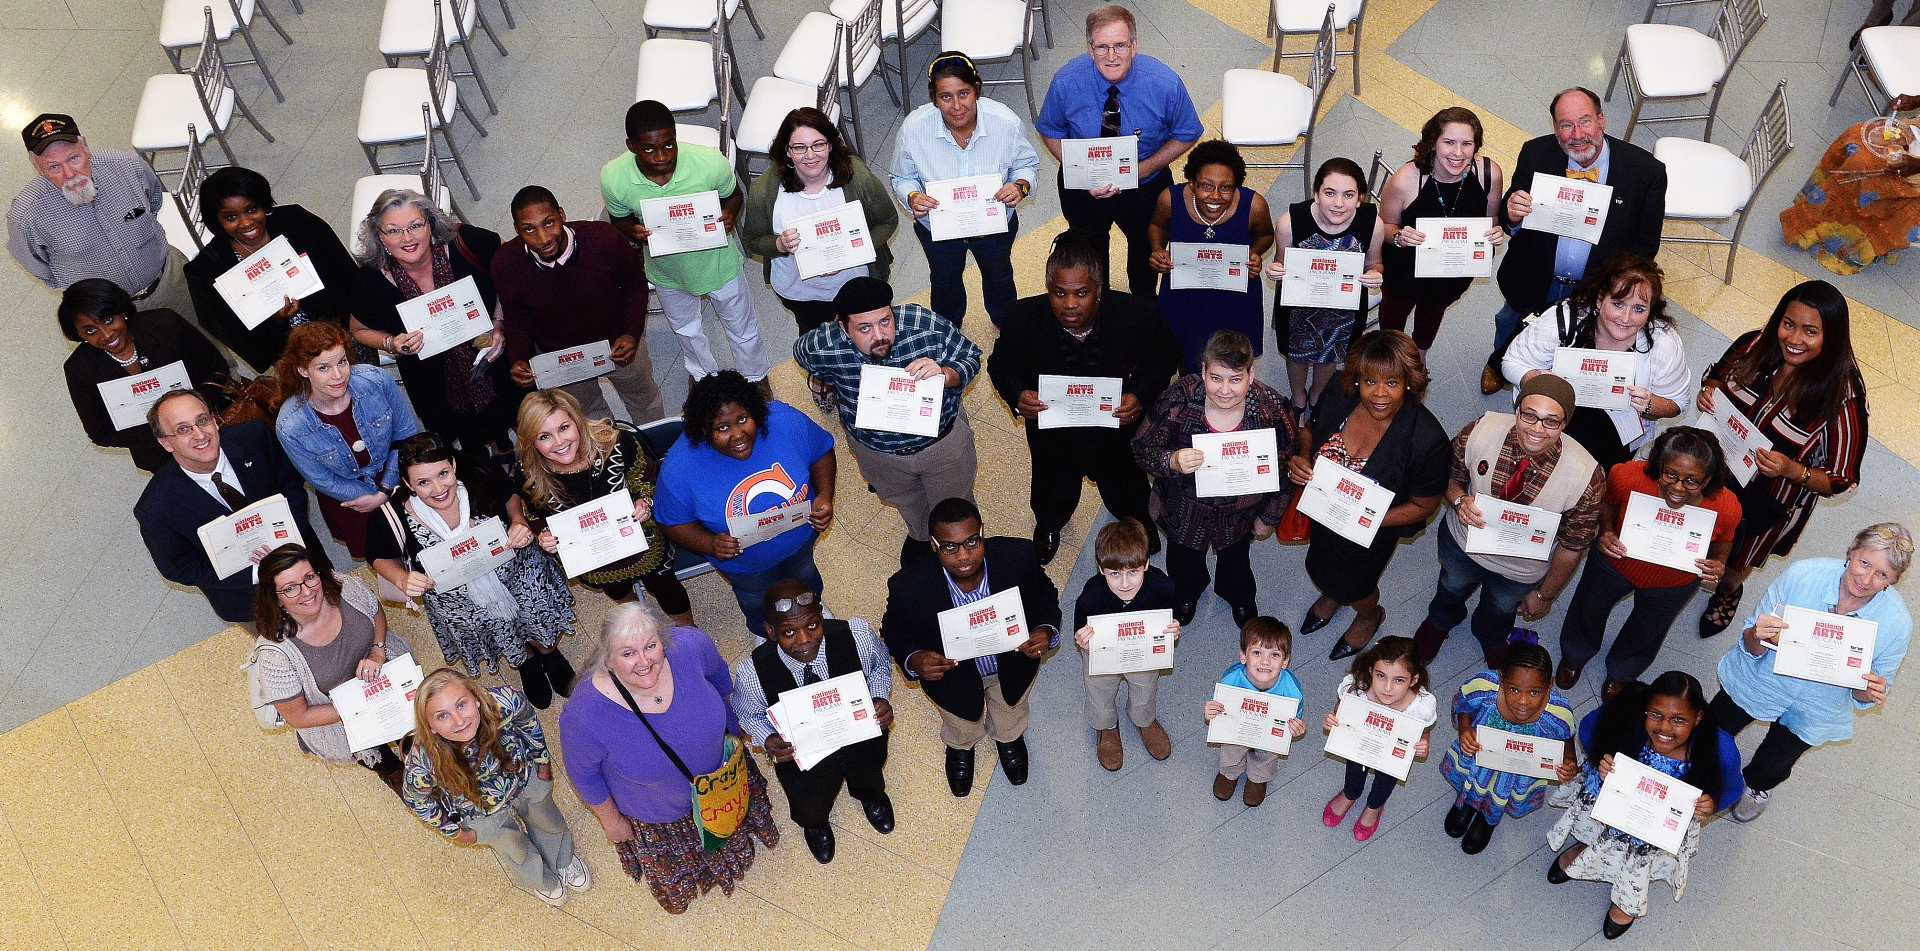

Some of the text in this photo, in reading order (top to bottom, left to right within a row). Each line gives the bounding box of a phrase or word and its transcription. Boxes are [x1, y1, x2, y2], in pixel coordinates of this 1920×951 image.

[1088, 150, 1112, 158] ARTS
[954, 190, 978, 200] ARTS
[1557, 191, 1584, 203] ARTS
[670, 208, 695, 218] ARTS
[816, 224, 841, 236] ARTS
[1443, 232, 1468, 240] ARTS
[247, 261, 272, 280] ARTS
[1311, 263, 1337, 272] ARTS
[428, 299, 455, 315] ARTS
[558, 354, 585, 364] ARTS
[1581, 363, 1608, 373] ARTS
[132, 380, 161, 394] ARTS
[889, 382, 916, 393] ARTS
[1727, 418, 1748, 440] ARTS
[1222, 446, 1249, 456] ARTS
[1336, 482, 1363, 500] ARTS
[580, 513, 607, 529] ARTS
[1500, 514, 1529, 526] ARTS
[1656, 512, 1685, 526] ARTS
[236, 518, 263, 534] ARTS
[451, 540, 479, 558] ARTS
[970, 611, 997, 627] ARTS
[1118, 626, 1145, 637] ARTS
[1813, 627, 1844, 641] ARTS
[363, 680, 392, 698] ARTS
[813, 693, 841, 709] ARTS
[1241, 702, 1268, 715] ARTS
[1365, 716, 1393, 732] ARTS
[1506, 743, 1534, 754] ARTS
[1637, 781, 1667, 800] ARTS
